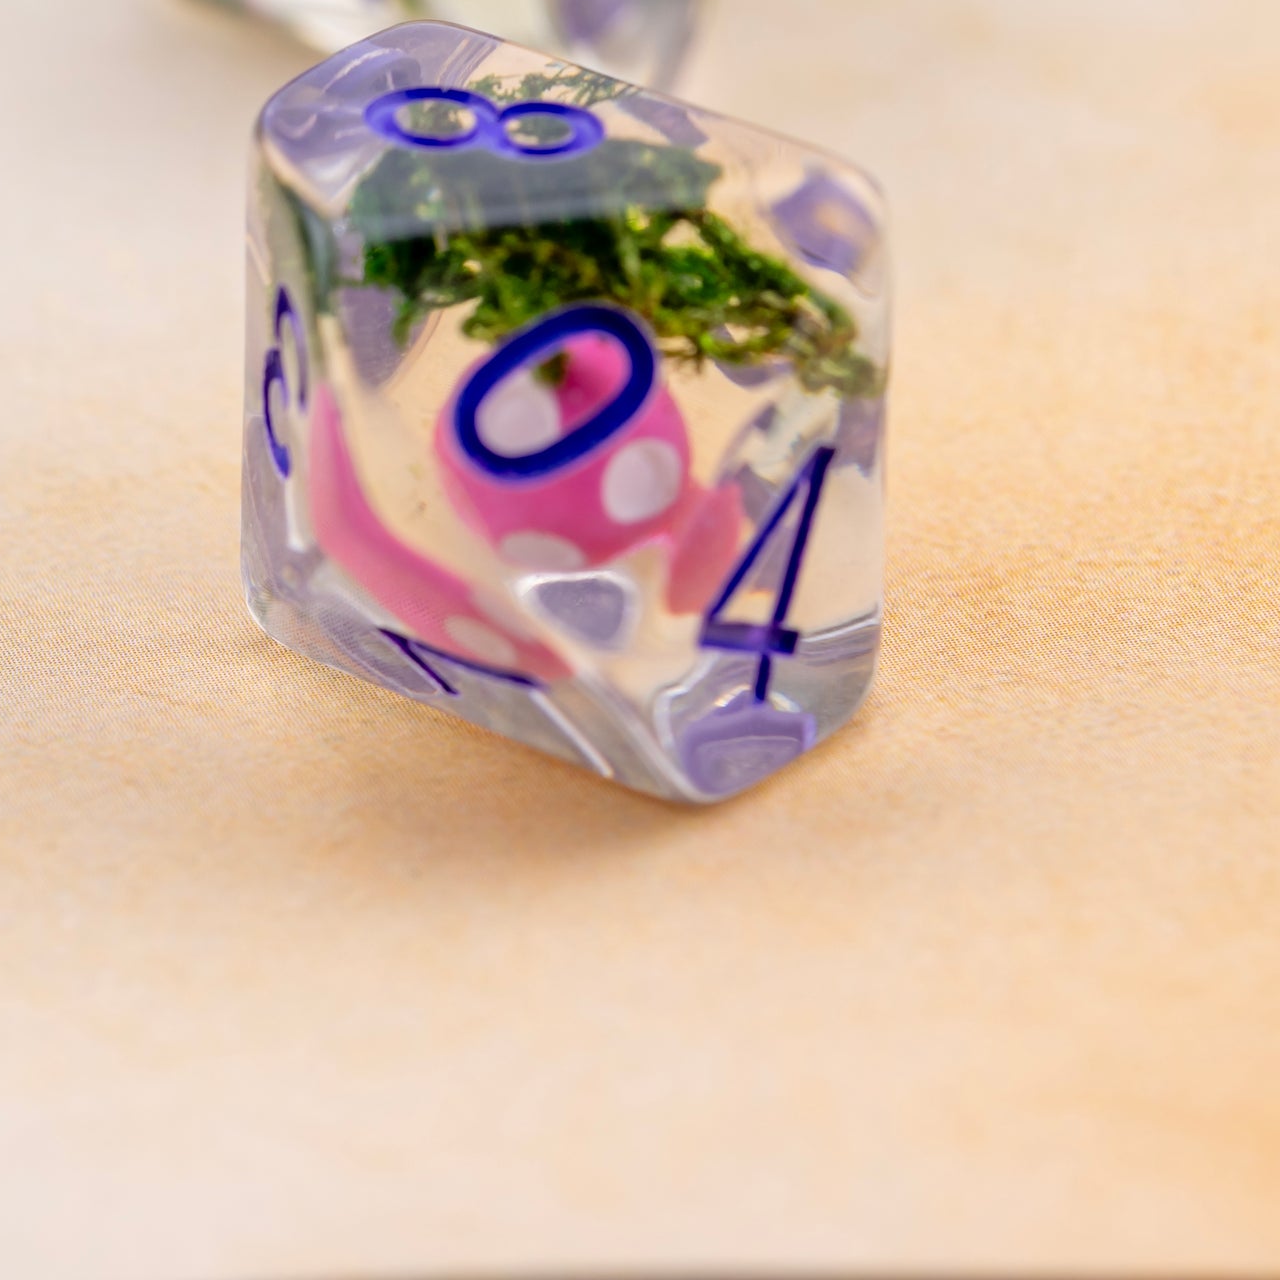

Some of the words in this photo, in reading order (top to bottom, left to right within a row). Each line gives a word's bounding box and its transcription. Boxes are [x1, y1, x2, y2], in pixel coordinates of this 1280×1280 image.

[364, 86, 606, 160] 8
[454, 302, 661, 487] 0
[698, 447, 836, 704] 4
